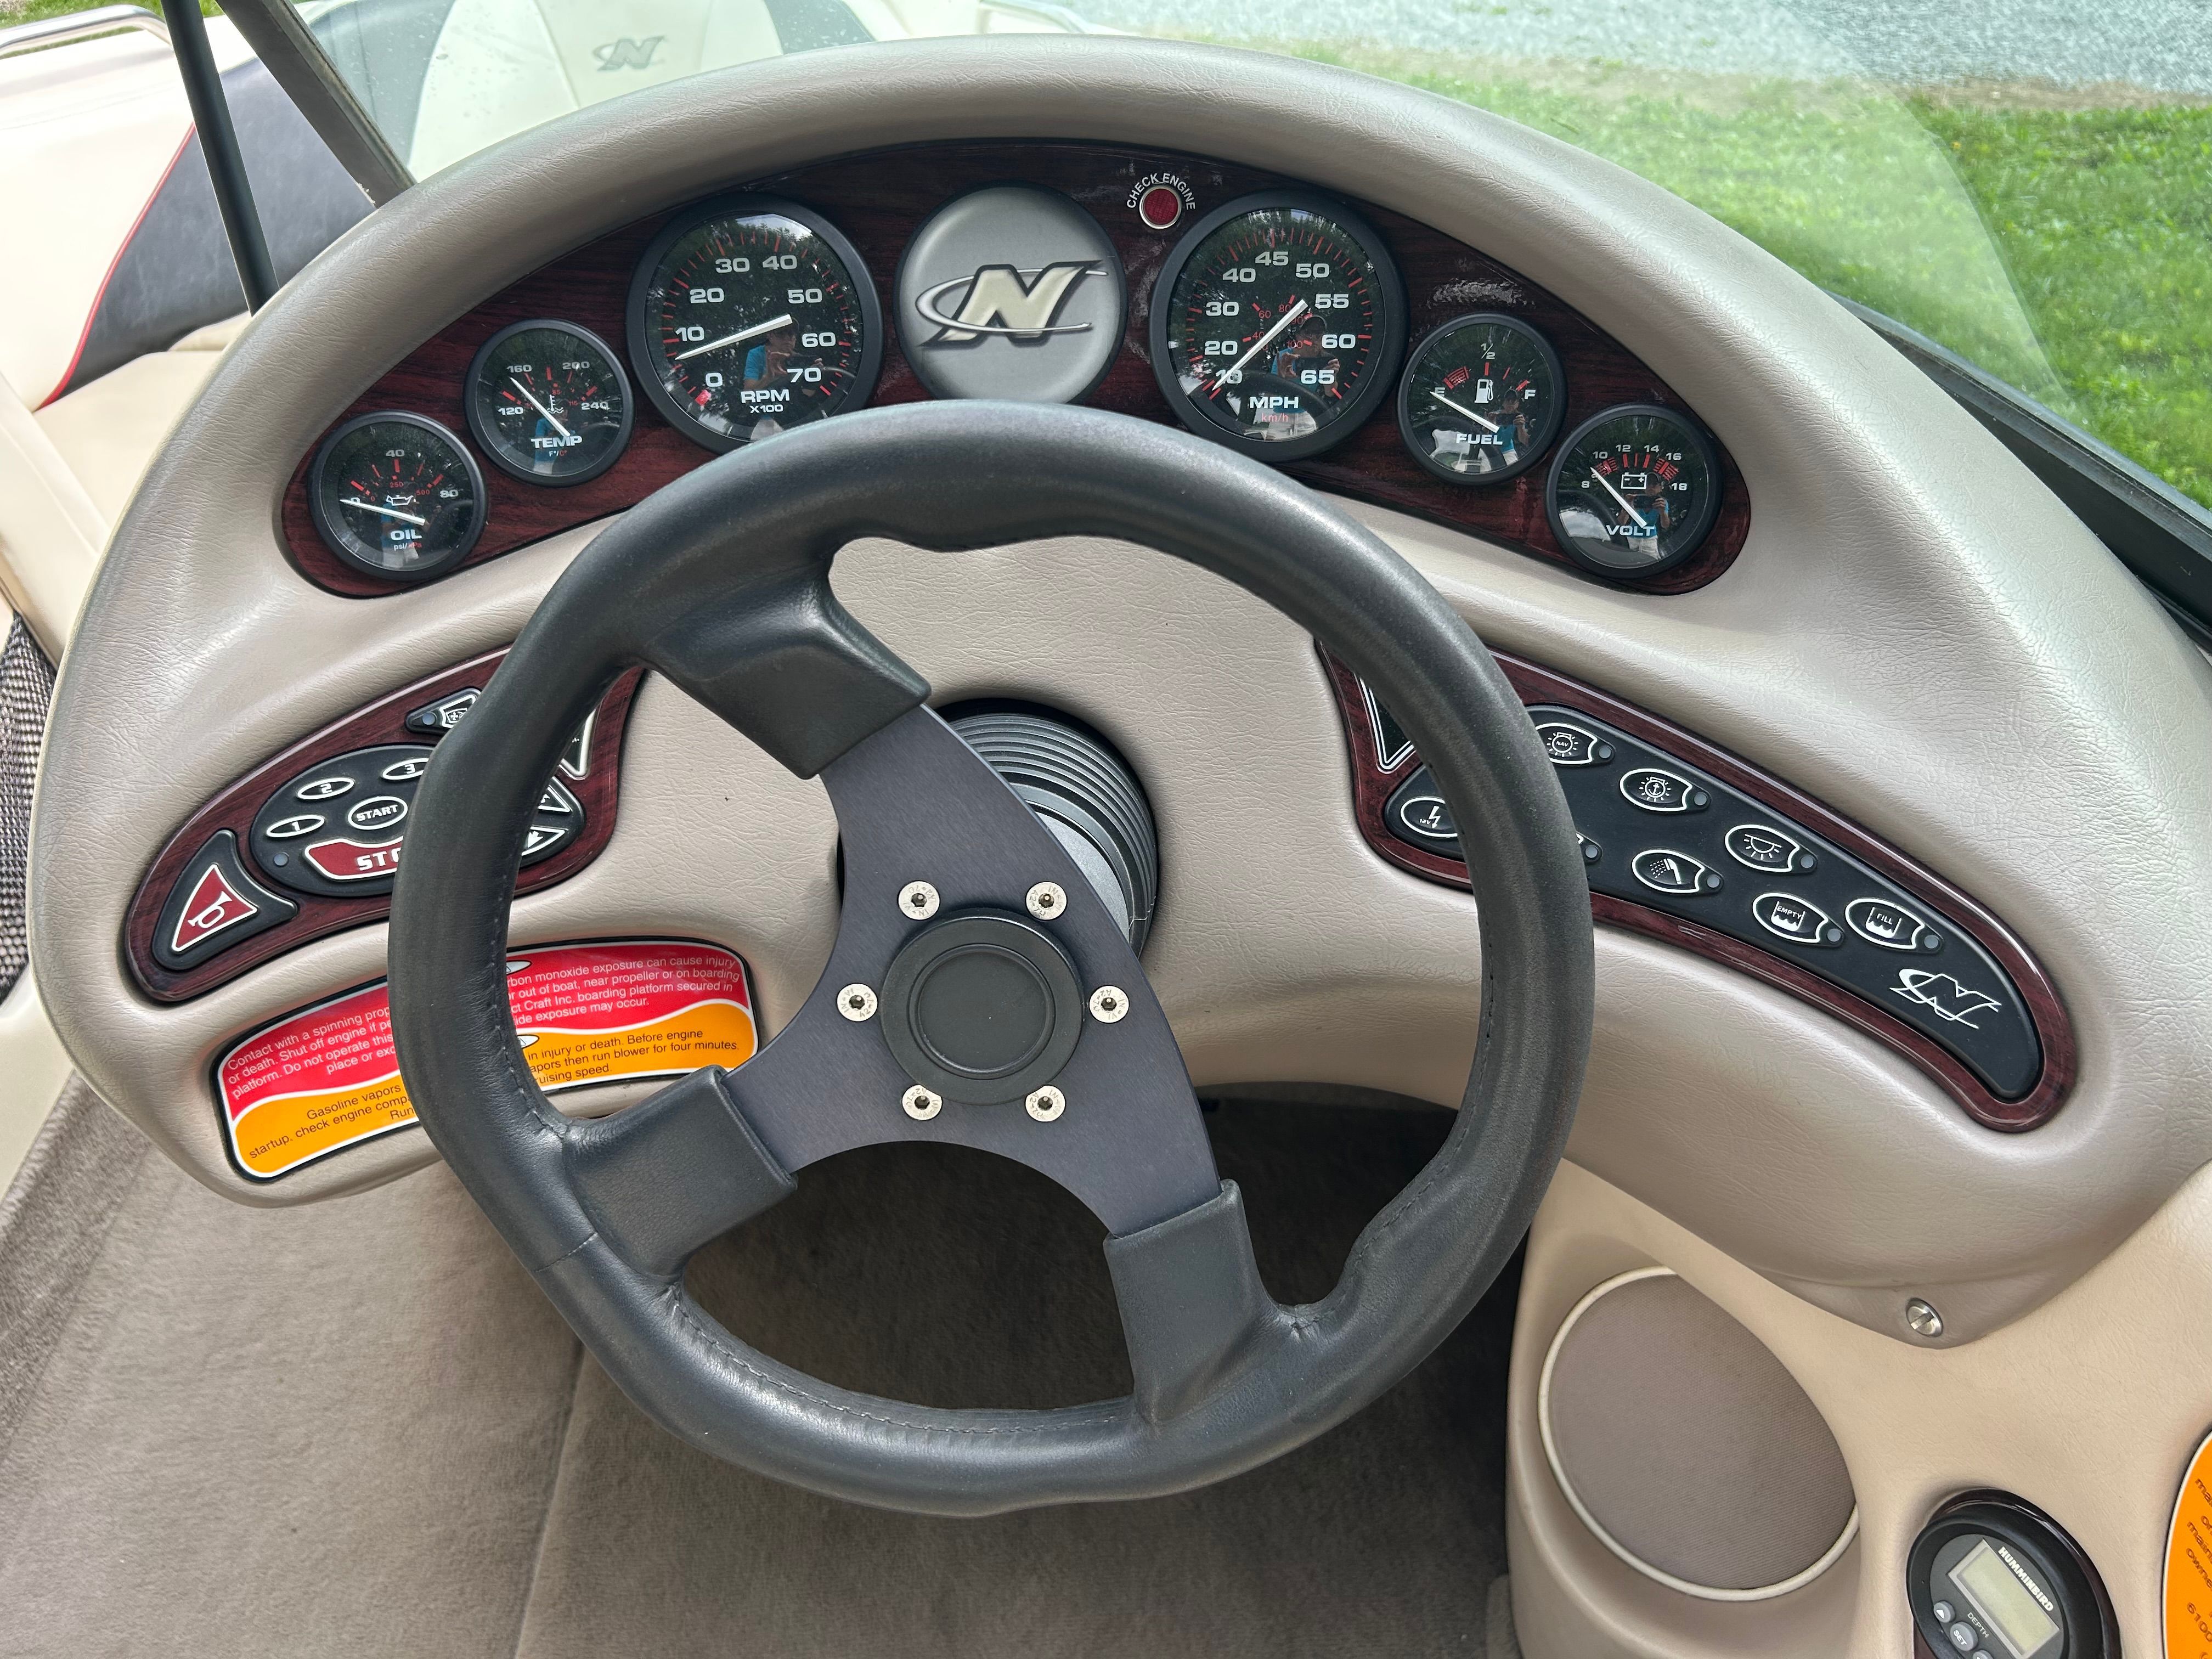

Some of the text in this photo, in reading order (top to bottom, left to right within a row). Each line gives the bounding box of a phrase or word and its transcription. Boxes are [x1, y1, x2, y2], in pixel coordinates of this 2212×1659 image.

[1126, 173, 1195, 210] CHECK ENGINE
[715, 257, 750, 273] 30
[763, 255, 798, 270] 40
[1255, 251, 1289, 266] 45
[1222, 268, 1256, 283] 40
[1295, 263, 1330, 278] 50
[690, 288, 724, 303] 20
[788, 288, 822, 304] 50
[1314, 294, 1349, 308] 55
[1205, 301, 1239, 317] 30
[1259, 310, 1271, 318] 60
[675, 326, 704, 341] 10
[802, 332, 836, 348] 60
[1204, 341, 1238, 356] 20
[1322, 334, 1356, 349] 60
[507, 364, 532, 373] 160
[562, 362, 590, 370] 200
[705, 373, 723, 387] 0
[787, 368, 821, 383] 70
[1300, 370, 1334, 385] 65
[741, 390, 790, 403] RPM
[1435, 387, 1446, 397] E
[1525, 390, 1536, 399] F
[581, 402, 608, 410] 240
[750, 404, 783, 413] X100
[1250, 397, 1299, 409] MPH
[498, 407, 523, 415] 120
[1262, 413, 1289, 422] km/h
[531, 436, 582, 448] TEMP
[1456, 433, 1503, 445] FUEL
[1593, 451, 1608, 459] 10
[1616, 444, 1631, 453] 12
[1644, 444, 1660, 453] 14
[1666, 453, 1681, 461] 16
[439, 489, 459, 498] 80
[1671, 482, 1688, 491] 18
[390, 529, 422, 541] OIL
[1606, 525, 1655, 536] VOLT
[404, 763, 416, 774] 3
[320, 783, 333, 794] 2
[357, 804, 398, 822] START
[291, 821, 301, 831] 1
[1776, 905, 1802, 919] EMPTY
[1877, 912, 1893, 924] FILL
[228, 1044, 273, 1070] Contact
[275, 1035, 300, 1049] with
[302, 1031, 311, 1040] a
[313, 1015, 363, 1036] spinning
[365, 1007, 390, 1023] prop
[535, 966, 589, 982] monoxide
[593, 960, 644, 973] exposure
[647, 958, 666, 968] can
[670, 957, 702, 966] cause
[707, 956, 736, 969] injury
[228, 1073, 240, 1084] or
[242, 1058, 279, 1077] death.
[279, 1045, 308, 1061] Shut
[310, 1037, 324, 1051] off
[328, 1027, 367, 1045] engine
[369, 1022, 376, 1032] if
[519, 988, 536, 998] out
[539, 986, 549, 995] of
[554, 980, 581, 992] boat,
[584, 978, 608, 988] near
[612, 971, 658, 986] propeller
[663, 970, 673, 979] or
[693, 968, 740, 983] boarding
[232, 1071, 283, 1100] platform.
[283, 1063, 301, 1075] Do
[304, 1054, 324, 1068] not
[326, 1040, 370, 1060] operate
[373, 1034, 393, 1046] this
[524, 999, 551, 1011] Craft
[555, 996, 575, 1006] Inc.
[578, 988, 626, 1002] boarding
[630, 983, 673, 997] platform
[677, 981, 720, 991] secured
[724, 983, 732, 991] in
[326, 1057, 358, 1076] place
[362, 1052, 373, 1062] or
[535, 1006, 586, 1022] exposure
[591, 1001, 613, 1012] may
[617, 997, 649, 1008] occur.
[307, 1030, 703, 1120] Gasoline vapors in injury or death. Before engine
[296, 1119, 330, 1138] check
[333, 1105, 372, 1125] engine
[565, 1056, 589, 1066] then
[592, 1052, 610, 1061] run
[614, 1047, 650, 1058] blower
[653, 1044, 667, 1053] for
[671, 1042, 691, 1051] four
[695, 1041, 739, 1050] minutes.
[390, 1108, 414, 1120] Run
[575, 1063, 612, 1078] speed.
[1998, 1546, 2053, 1611] HUMMINBIRD
[1967, 1612, 1989, 1638] DEPTH
[1953, 1629, 1967, 1645] SET
